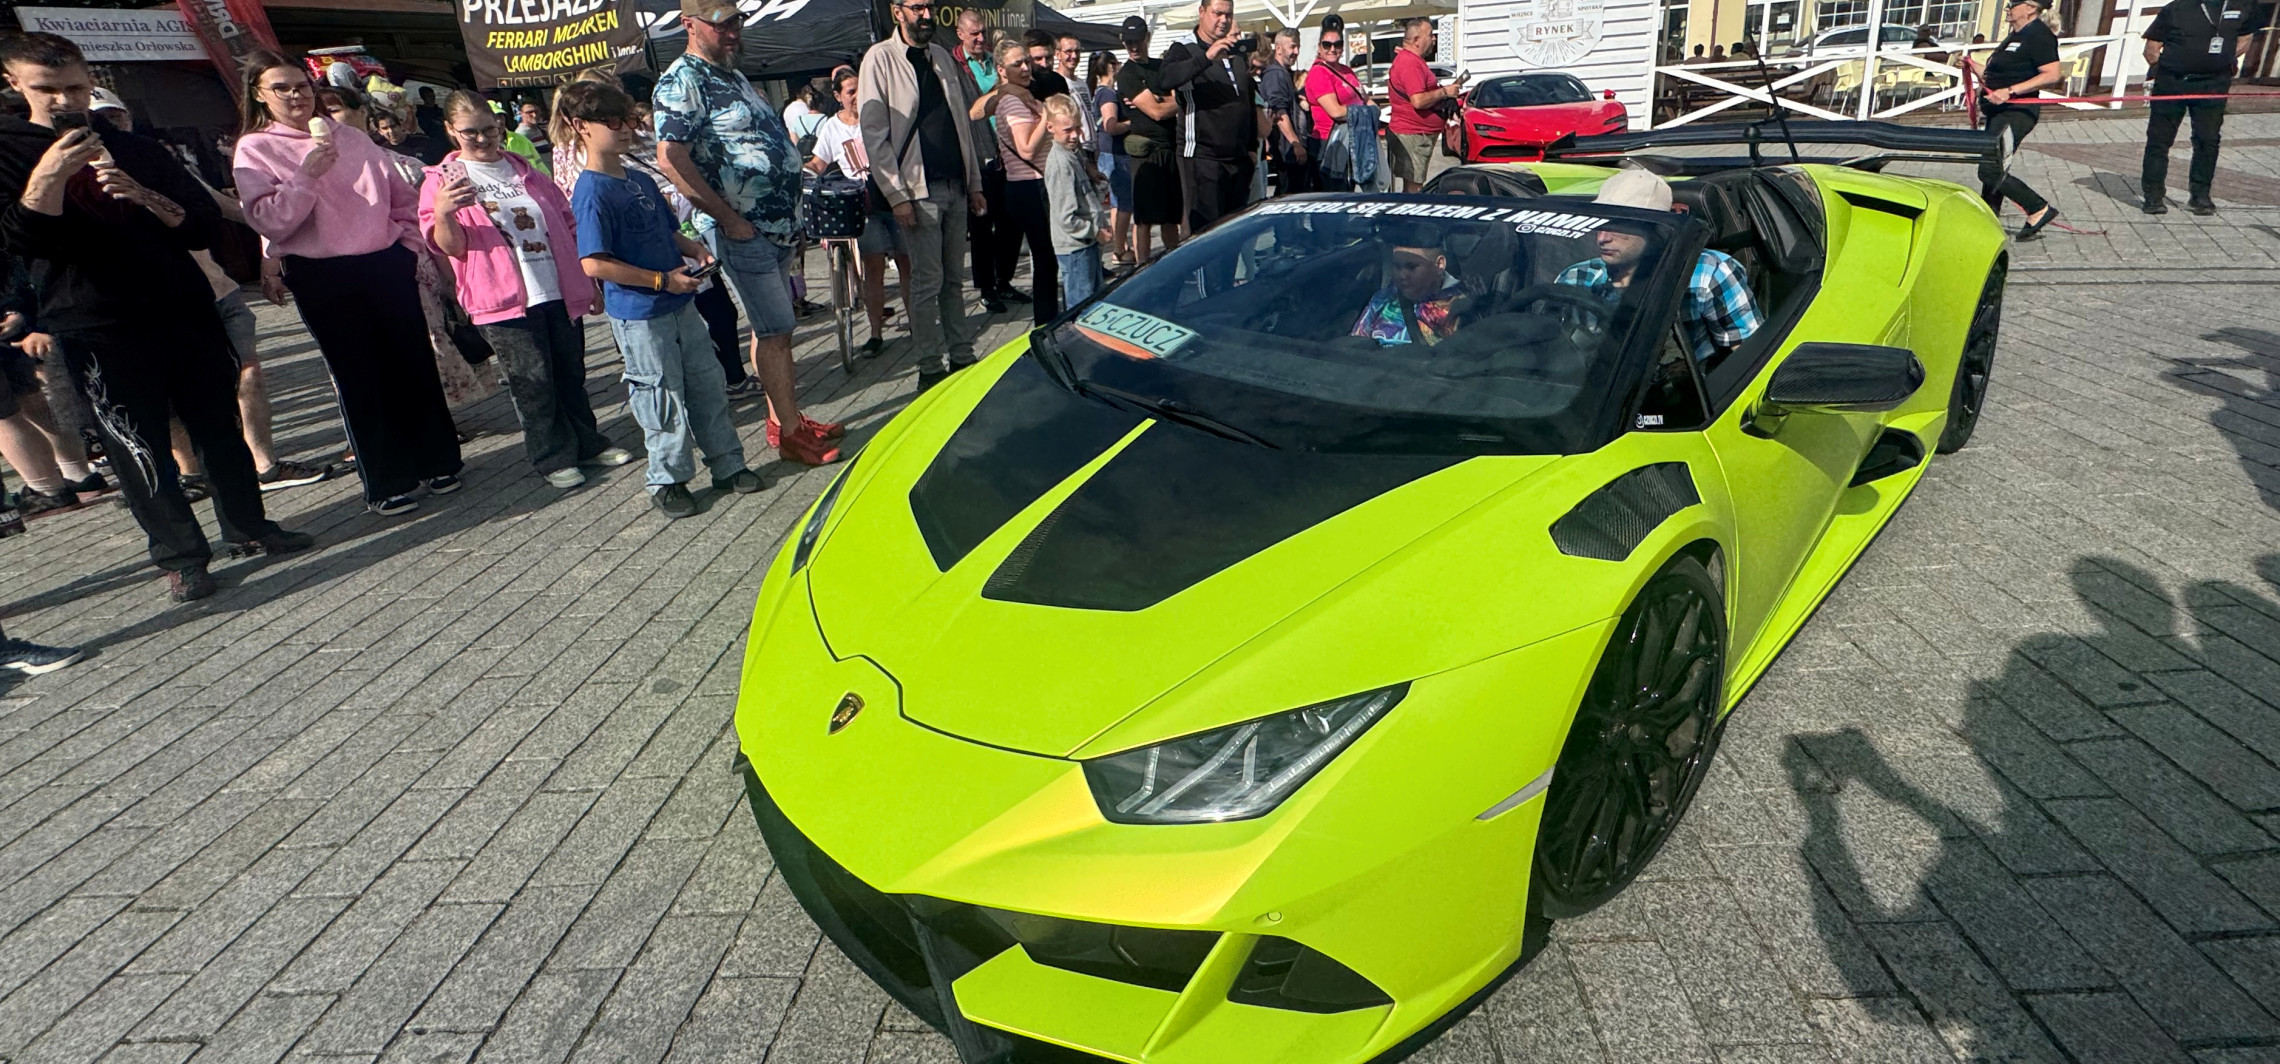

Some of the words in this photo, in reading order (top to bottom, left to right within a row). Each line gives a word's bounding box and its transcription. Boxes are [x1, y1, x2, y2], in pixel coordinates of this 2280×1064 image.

[34, 17, 151, 33] Kwiaciarnia
[486, 29, 548, 49] FERRARI
[552, 9, 619, 45] MCLAREN
[1535, 24, 1575, 36] RYNEK
[135, 41, 196, 52] Orłowska
[503, 40, 610, 73] LAMBORGHINI
[493, 188, 524, 200] Club
[1385, 203, 1488, 219] RAZEM
[1477, 208, 1512, 221] Z
